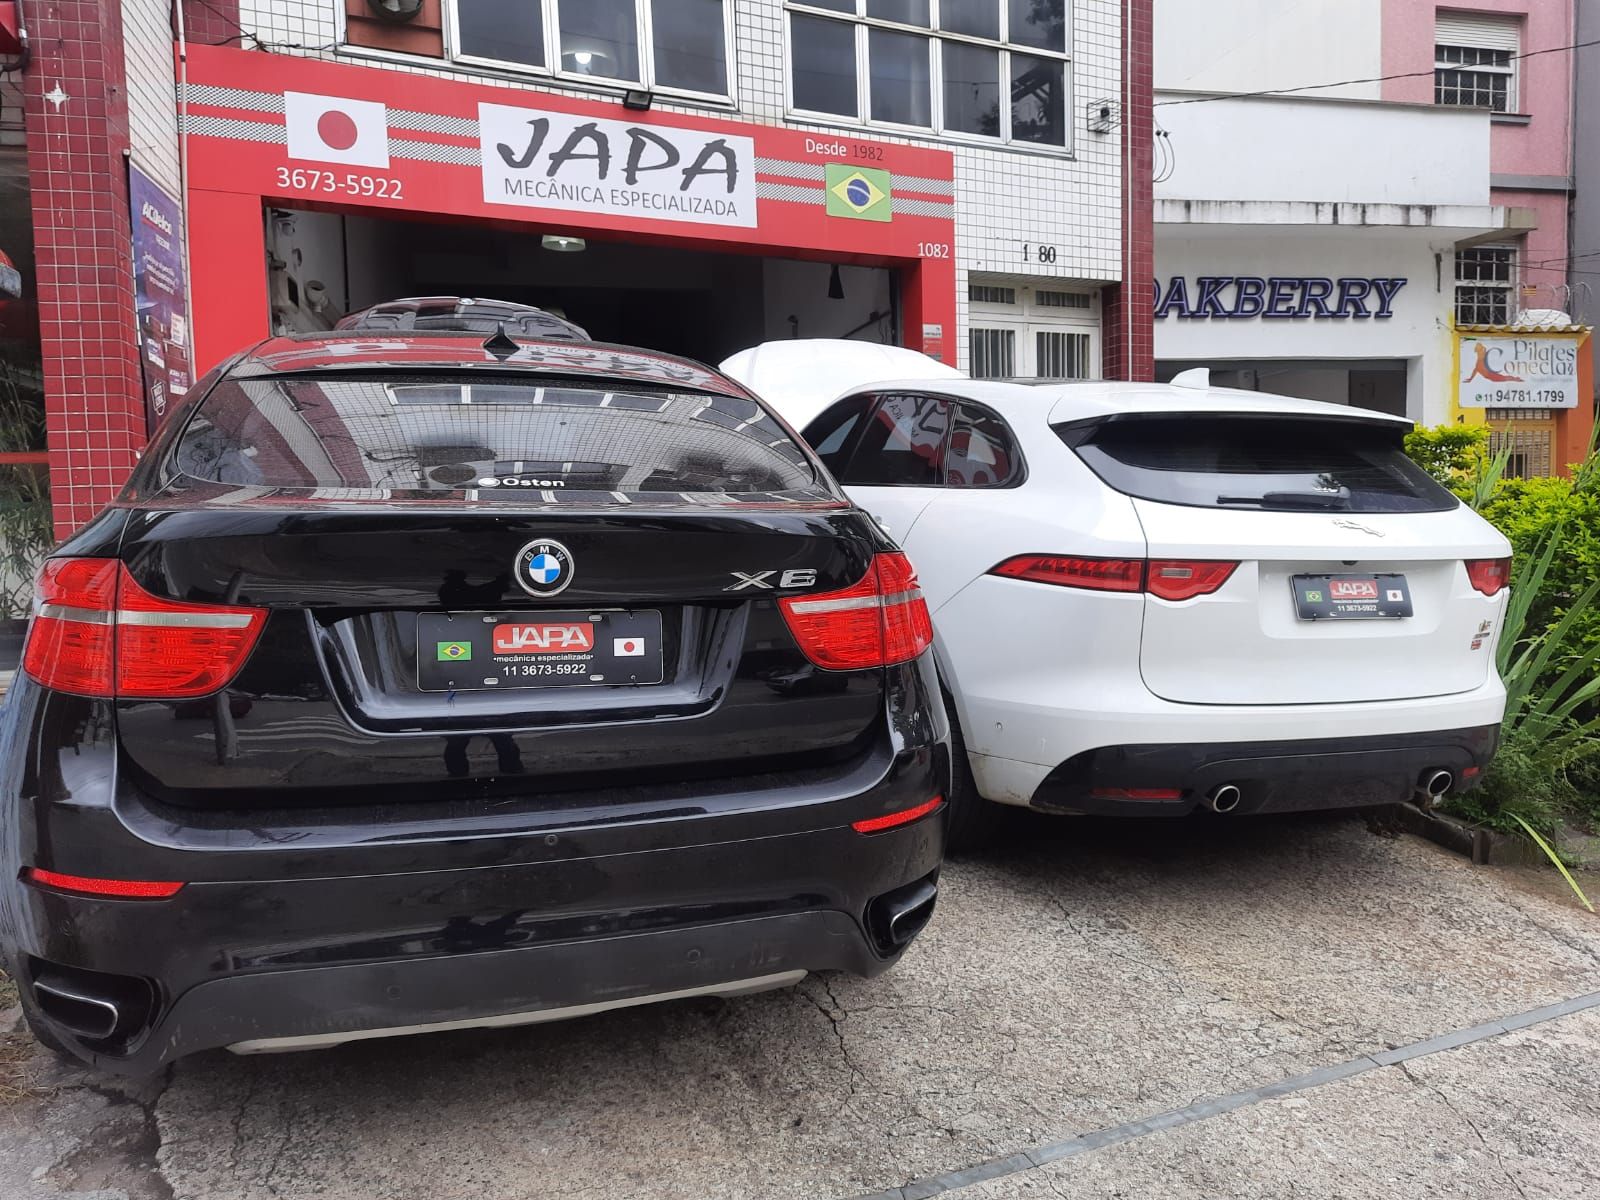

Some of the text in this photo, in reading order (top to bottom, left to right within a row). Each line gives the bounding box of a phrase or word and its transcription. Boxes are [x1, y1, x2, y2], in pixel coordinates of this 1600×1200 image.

[496, 117, 740, 194] JAPA
[805, 138, 884, 161] Desde 1982
[276, 166, 404, 200] 3673-5922
[504, 177, 738, 217] MECÂNICA ESPECIALIZADA
[917, 242, 950, 259] 1082
[1153, 276, 1407, 319] AKBERRY
[1513, 340, 1576, 362] Pilates
[1496, 390, 1565, 403] 94781.1799
[502, 478, 565, 487] Osten
[524, 545, 566, 562] BMW
[722, 568, 818, 592] X6
[1330, 582, 1376, 596] JAPA
[497, 626, 590, 649] JAPA
[503, 664, 587, 676] 11 3673-5922
